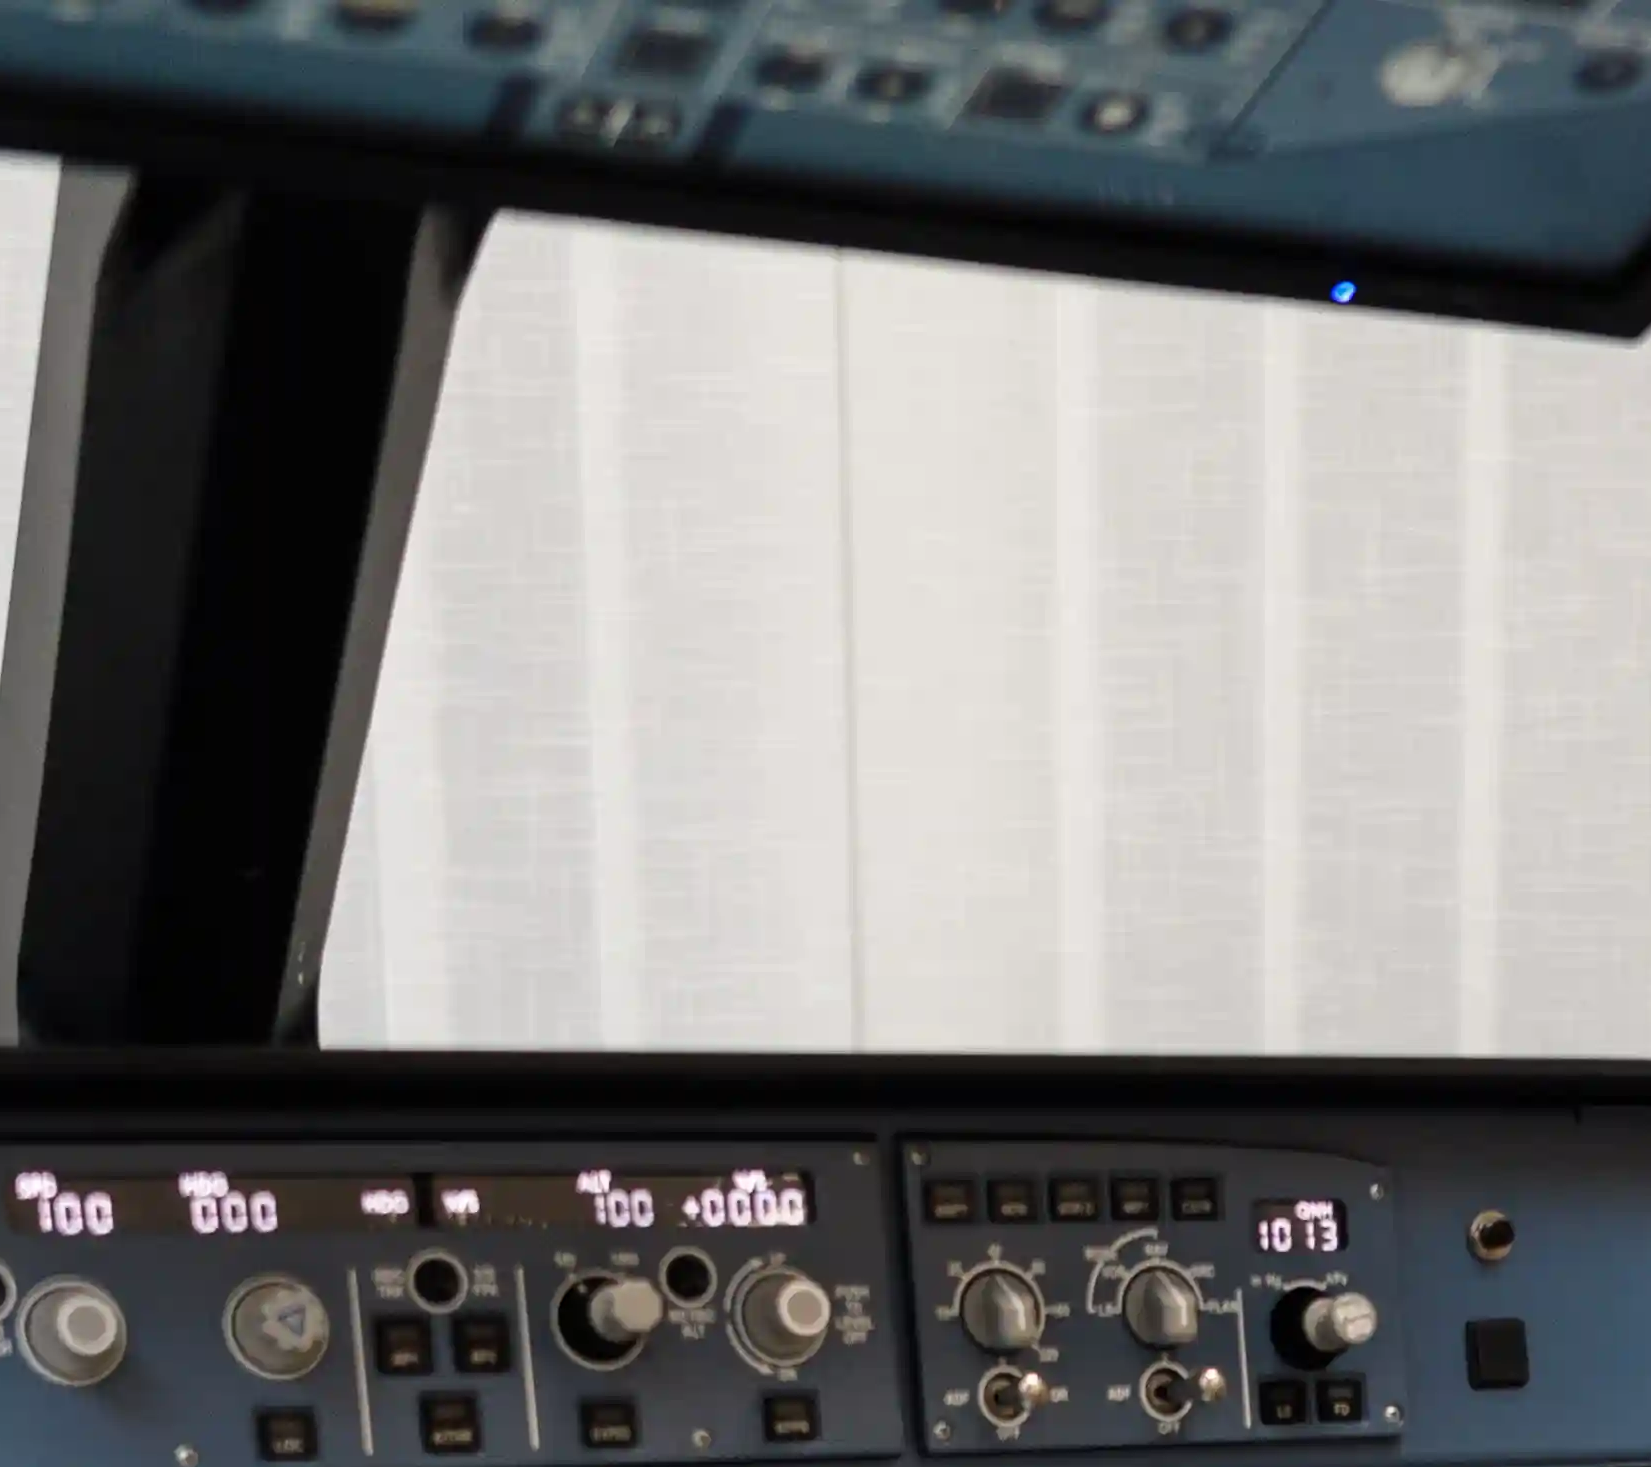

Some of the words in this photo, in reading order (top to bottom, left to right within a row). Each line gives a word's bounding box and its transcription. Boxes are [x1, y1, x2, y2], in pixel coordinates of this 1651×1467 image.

[37, 1192, 114, 1235] 100
[191, 1191, 278, 1233] 000
[594, 1190, 654, 1227] 100
[1294, 1201, 1333, 1220] QNH
[1257, 1218, 1338, 1252] 1013
